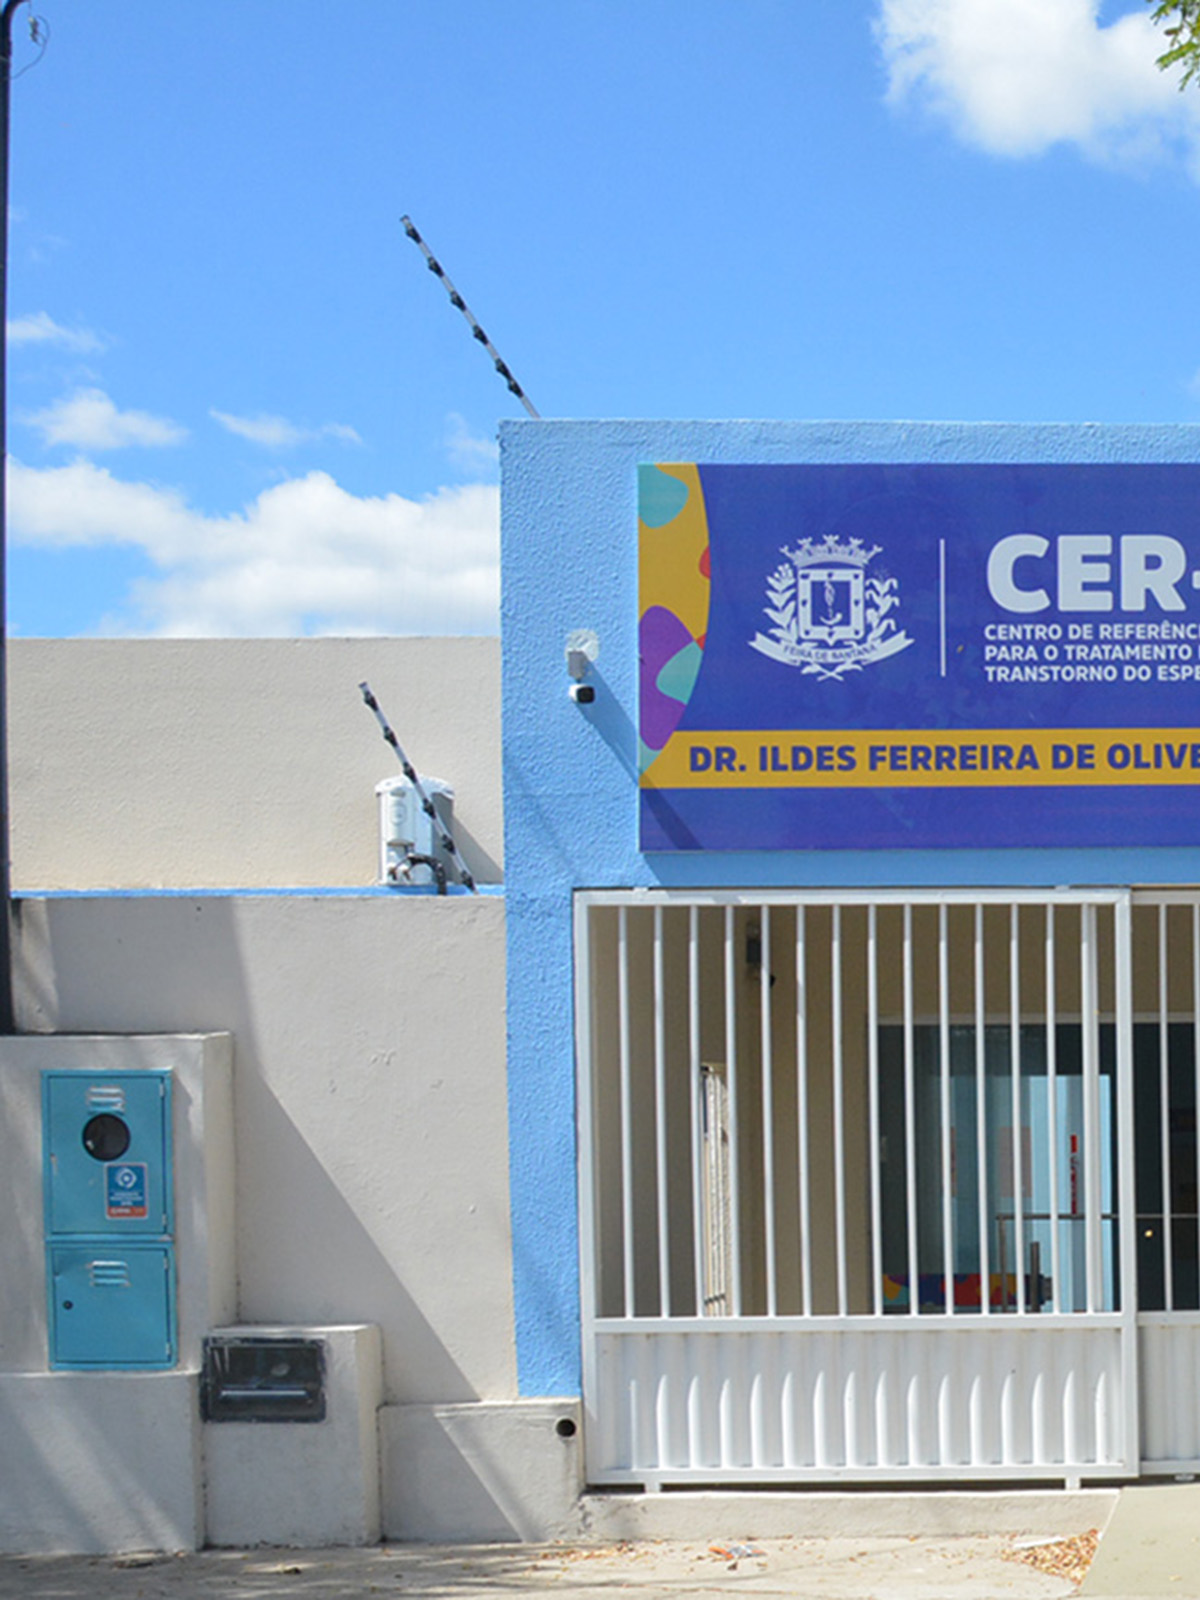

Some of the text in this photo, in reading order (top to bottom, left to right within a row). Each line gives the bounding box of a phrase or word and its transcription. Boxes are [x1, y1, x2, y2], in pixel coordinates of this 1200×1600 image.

[984, 623, 1063, 641] CENTRO
[1068, 623, 1093, 640] DE
[984, 644, 1039, 661] PARA
[1043, 644, 1059, 661] O
[1063, 643, 1193, 661] TRATAMENTO
[984, 664, 1118, 683] TRANSTORNO
[1123, 664, 1152, 682] DO
[689, 746, 747, 772] DR.
[759, 745, 857, 772] ILDES
[868, 744, 1040, 771] FERREIRA
[1051, 743, 1096, 770] DE
